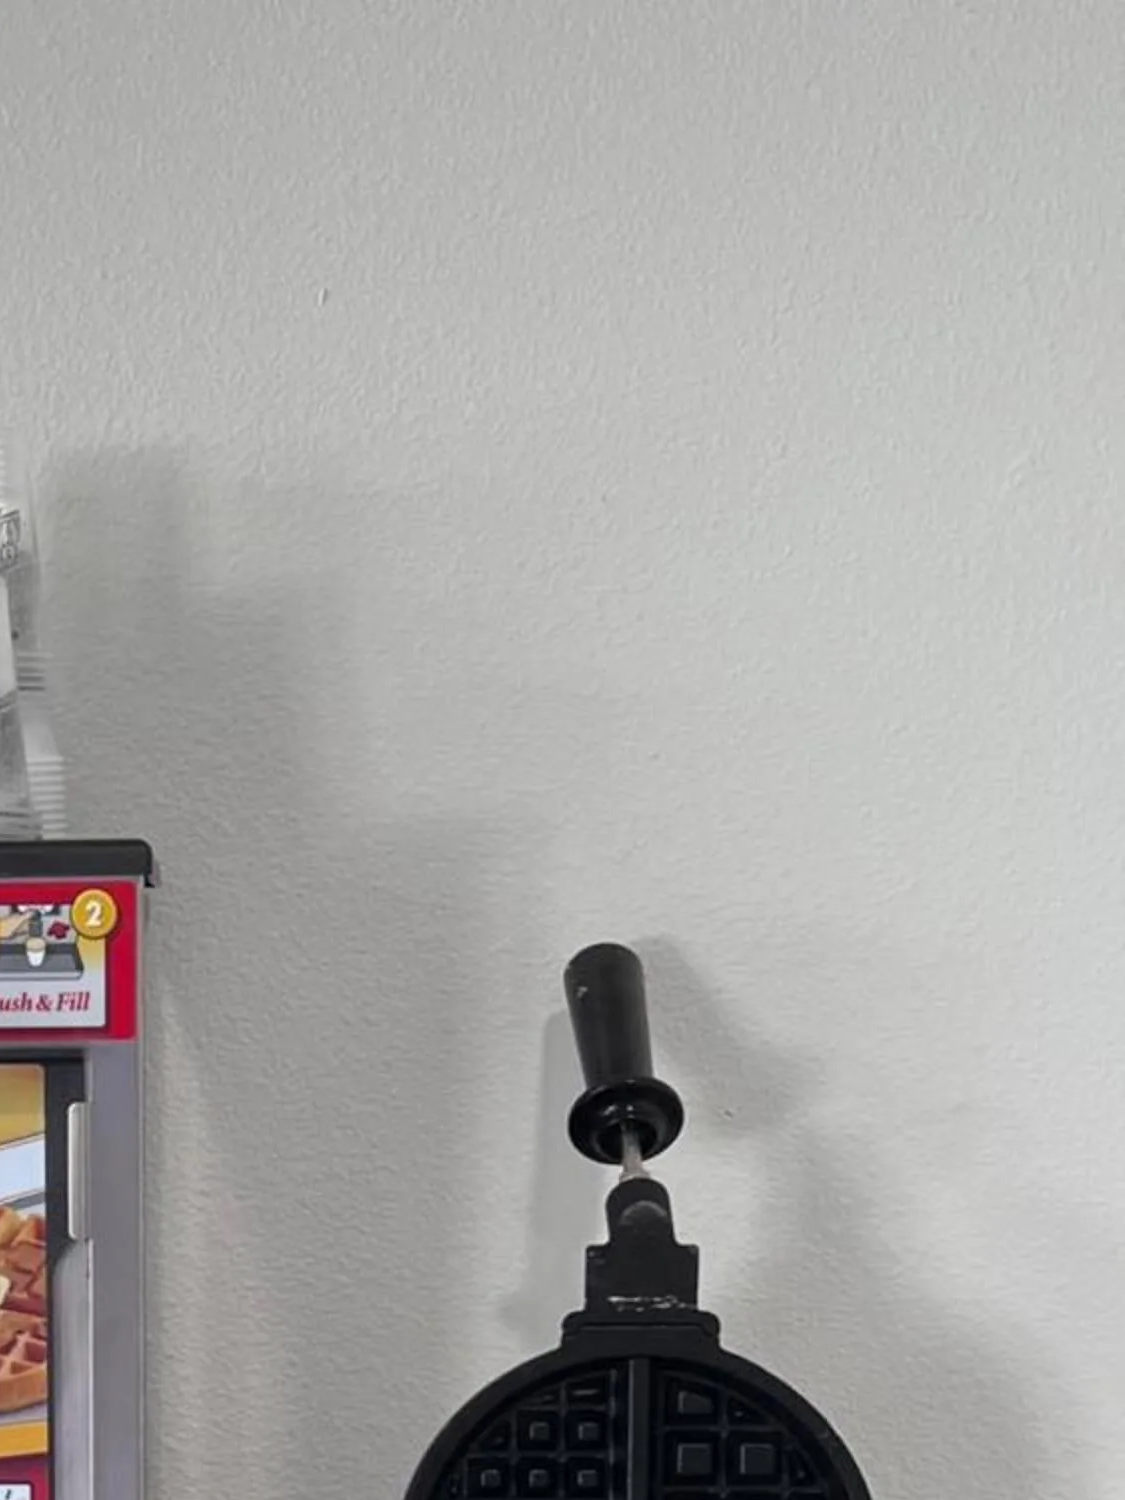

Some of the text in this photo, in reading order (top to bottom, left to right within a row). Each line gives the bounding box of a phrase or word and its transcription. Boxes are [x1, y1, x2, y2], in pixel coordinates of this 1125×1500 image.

[85, 902, 102, 927] 2
[36, 994, 52, 1011] &
[56, 991, 90, 1011] Fill
